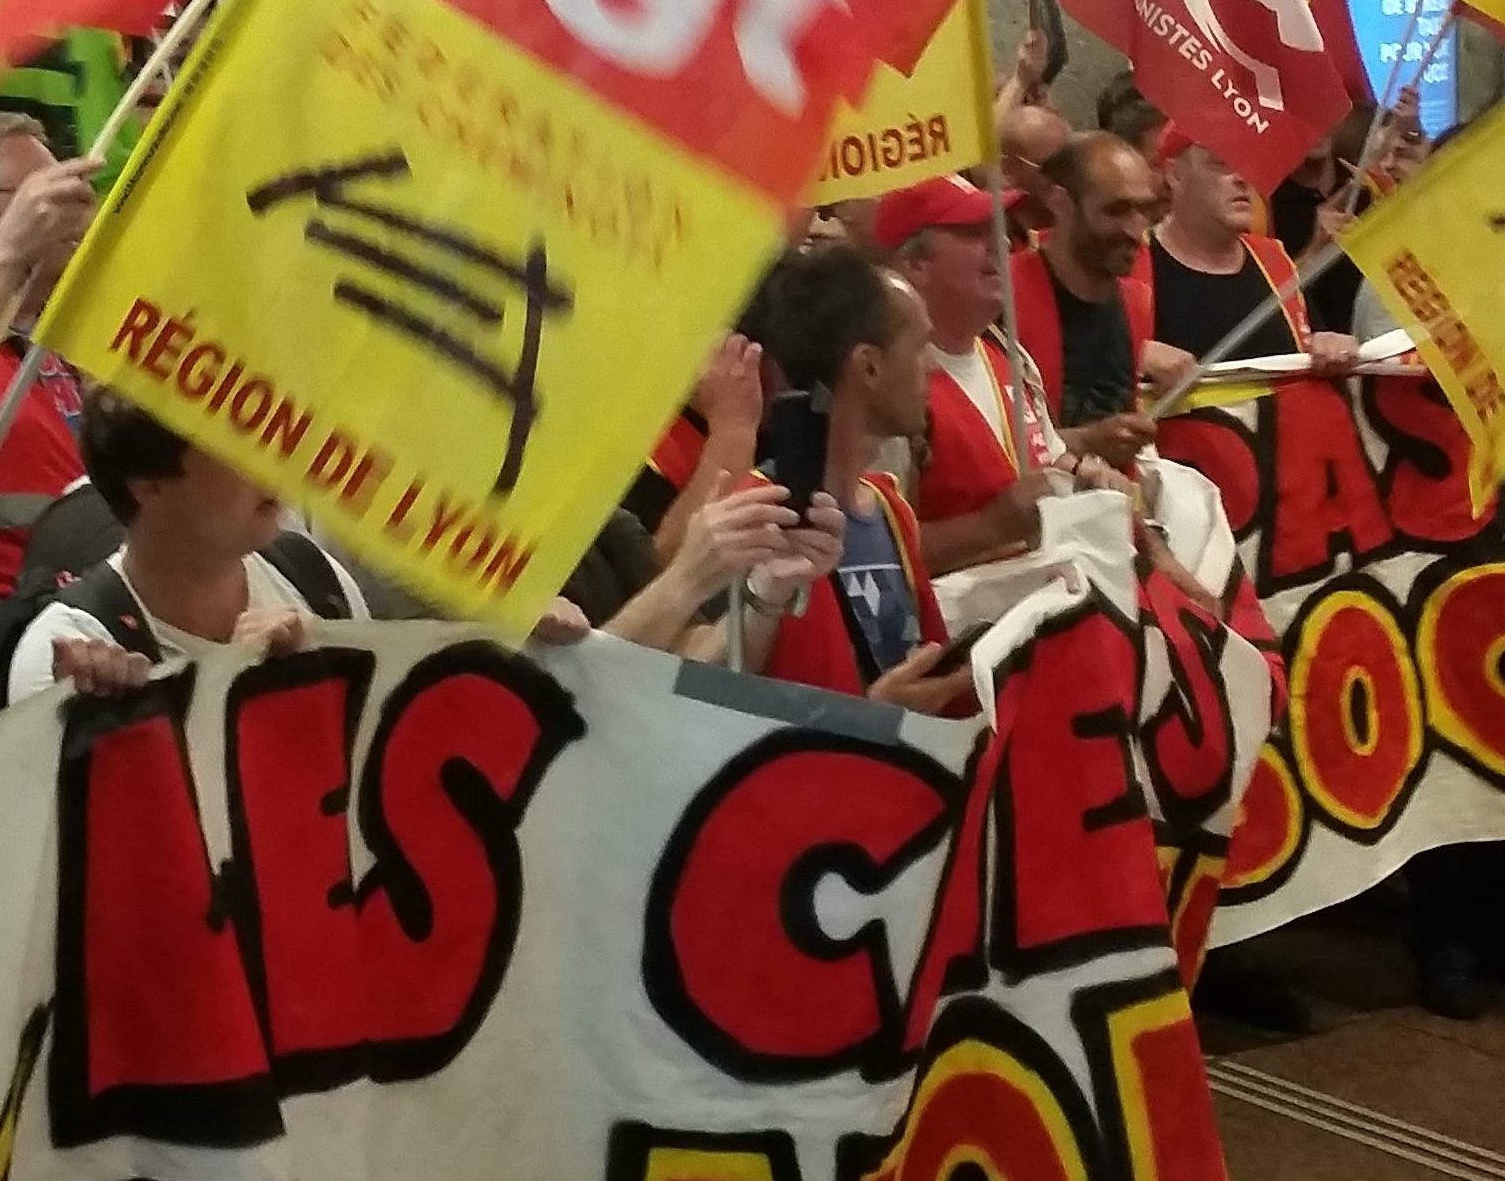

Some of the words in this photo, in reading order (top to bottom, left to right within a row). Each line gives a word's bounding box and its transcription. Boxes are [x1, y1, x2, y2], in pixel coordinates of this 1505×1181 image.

[1211, 68, 1270, 135] LYON
[109, 295, 314, 460] RÉGION
[306, 425, 395, 522] DE
[384, 477, 539, 597] LYON
[48, 638, 587, 1150] LES
